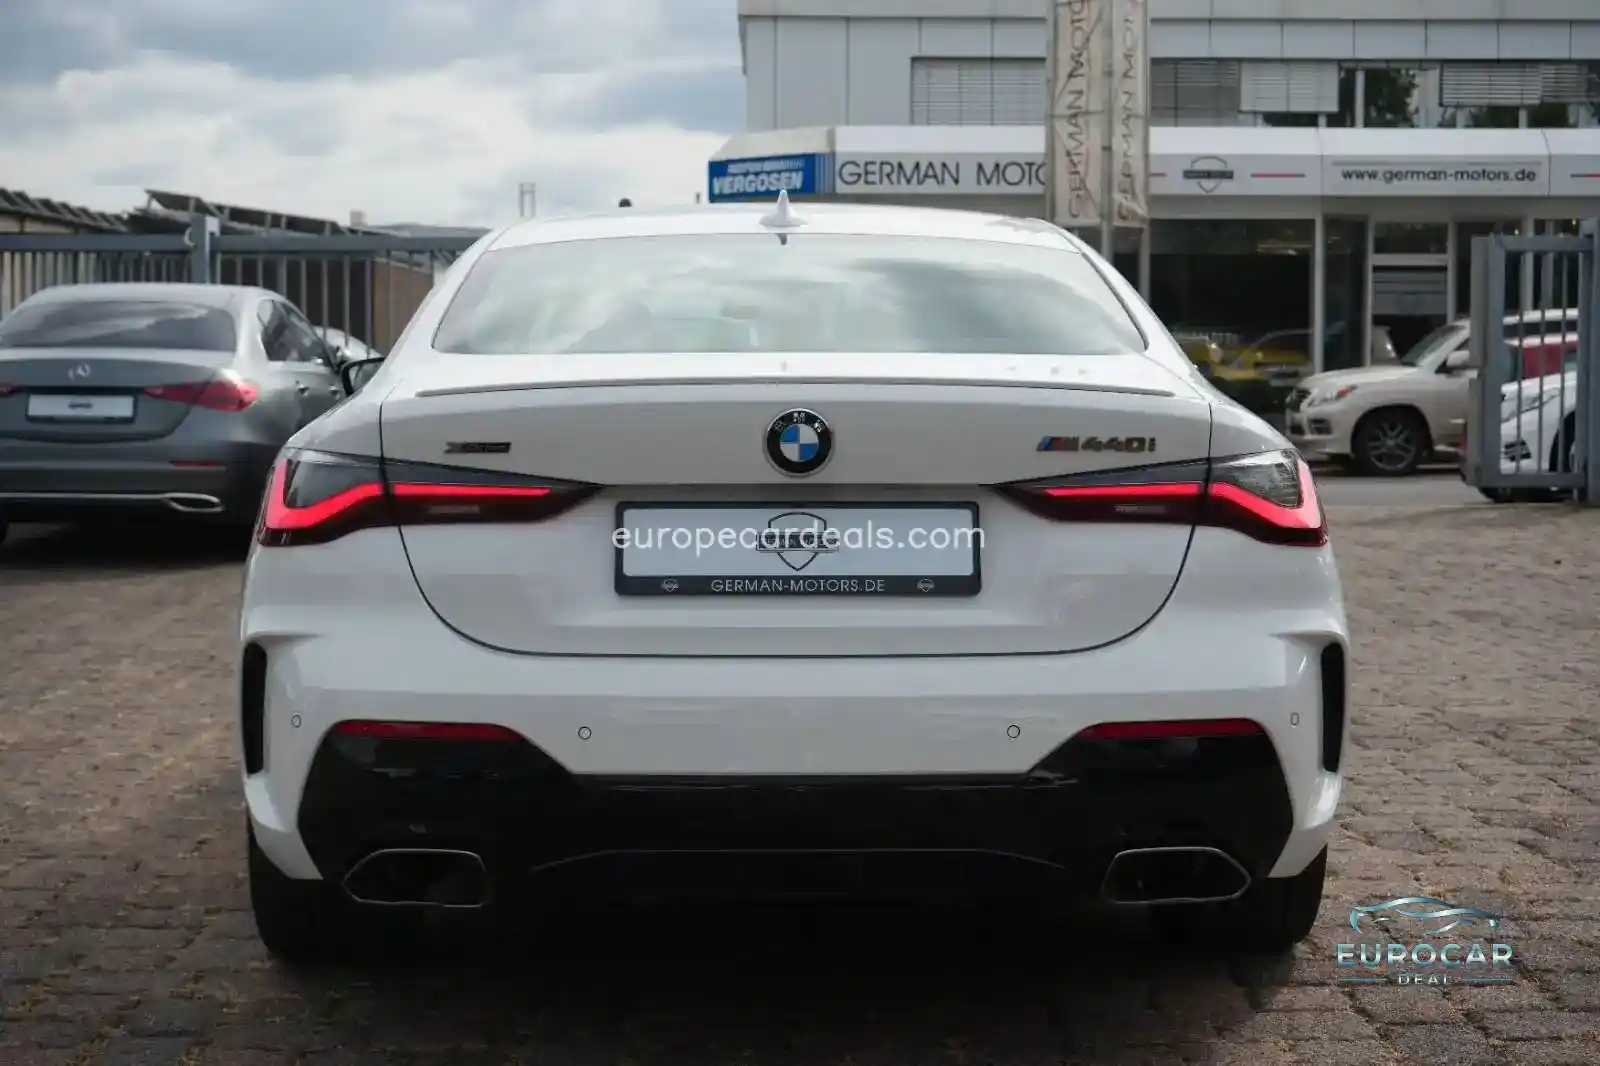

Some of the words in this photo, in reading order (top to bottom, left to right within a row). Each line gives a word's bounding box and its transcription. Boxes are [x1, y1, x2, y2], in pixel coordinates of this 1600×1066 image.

[838, 160, 960, 186] GERMAN
[1340, 168, 1536, 184] www.german-motors.de
[711, 579, 886, 593] GERMAN-MOTORS.DE
